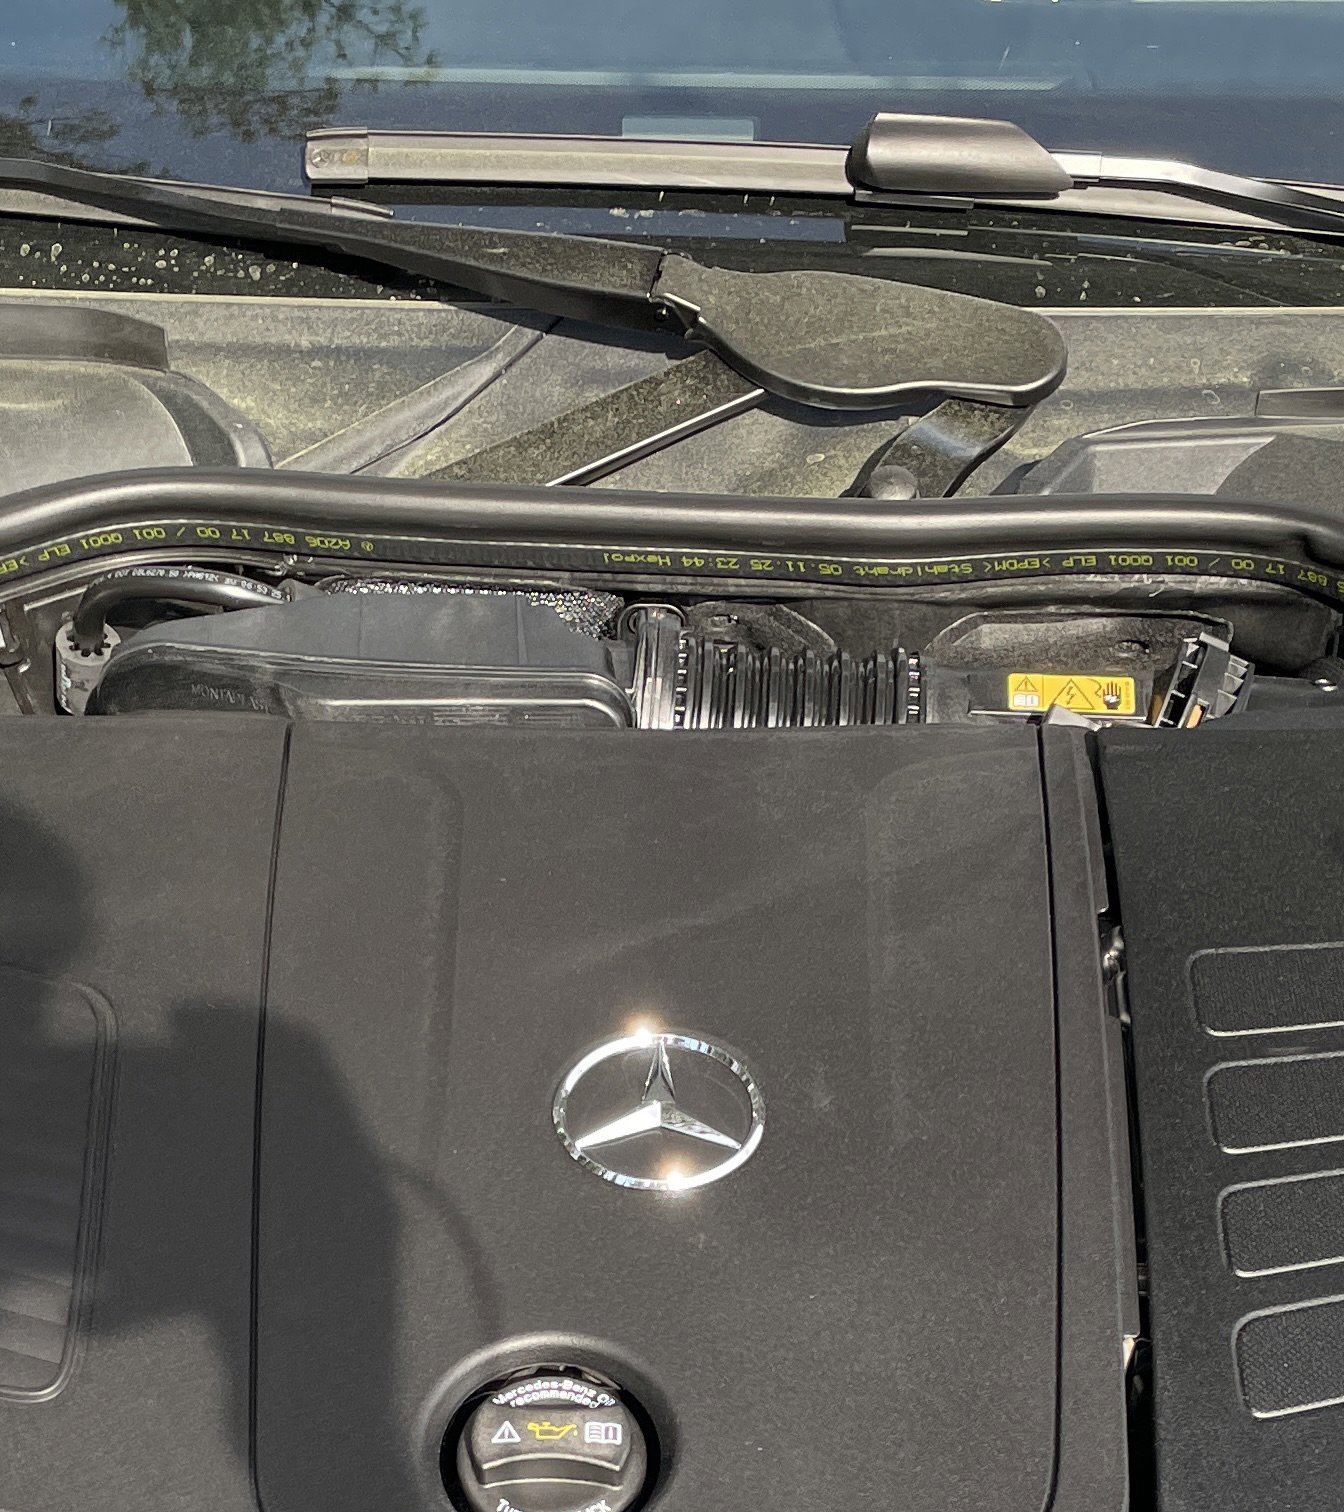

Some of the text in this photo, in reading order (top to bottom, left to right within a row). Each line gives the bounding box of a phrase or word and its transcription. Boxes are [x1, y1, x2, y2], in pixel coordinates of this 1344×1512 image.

[492, 1379, 617, 1409] Mercedes-Benz Oil
[510, 1389, 602, 1409] recommended
